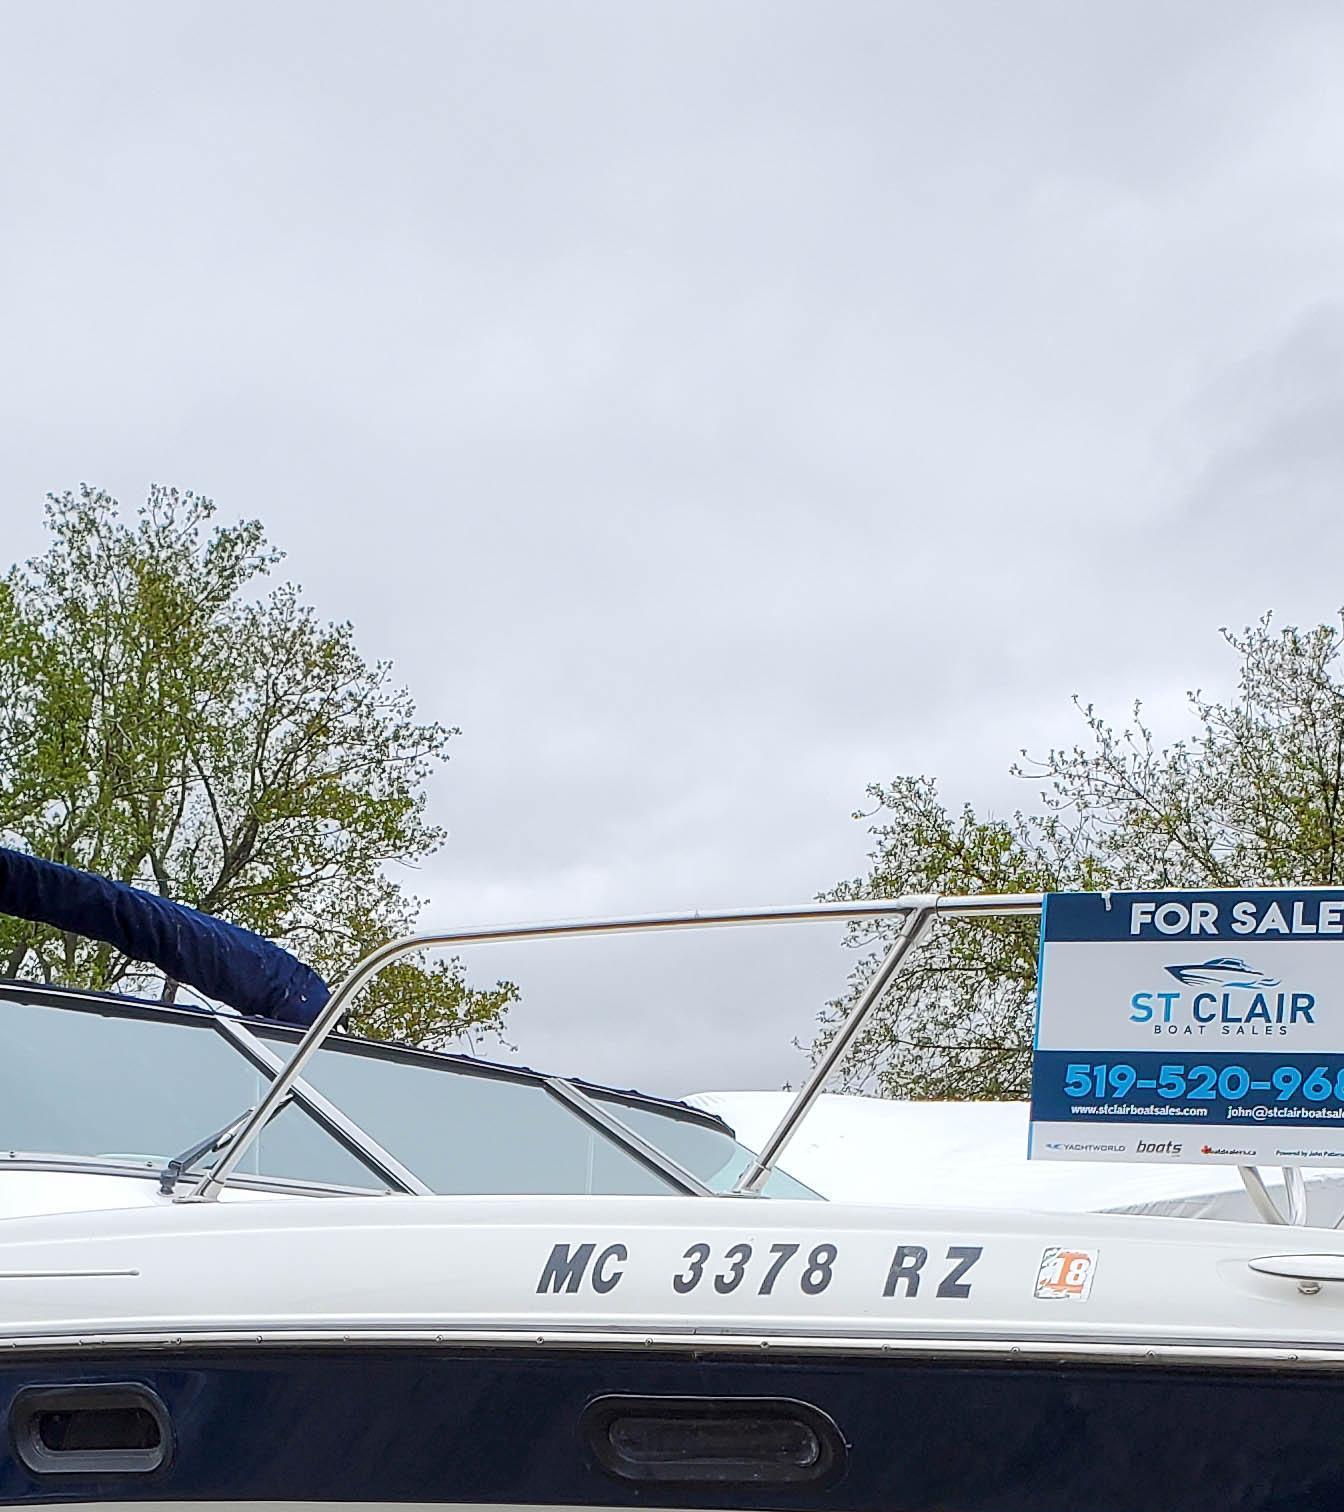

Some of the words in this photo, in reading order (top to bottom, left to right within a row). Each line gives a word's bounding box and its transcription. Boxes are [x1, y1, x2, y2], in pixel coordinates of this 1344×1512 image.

[1130, 901, 1220, 935] FOR
[1231, 900, 1344, 935] SALE
[1129, 992, 1181, 1023] ST
[1192, 992, 1316, 1025] CLAIR
[1153, 1024, 1207, 1036] BOAT
[1222, 1024, 1289, 1037] SALES
[1070, 1104, 1208, 1117] www.stclairboatsales.com
[1136, 1139, 1183, 1154] boats
[536, 1243, 628, 1295] MC
[673, 1243, 839, 1296] 3378
